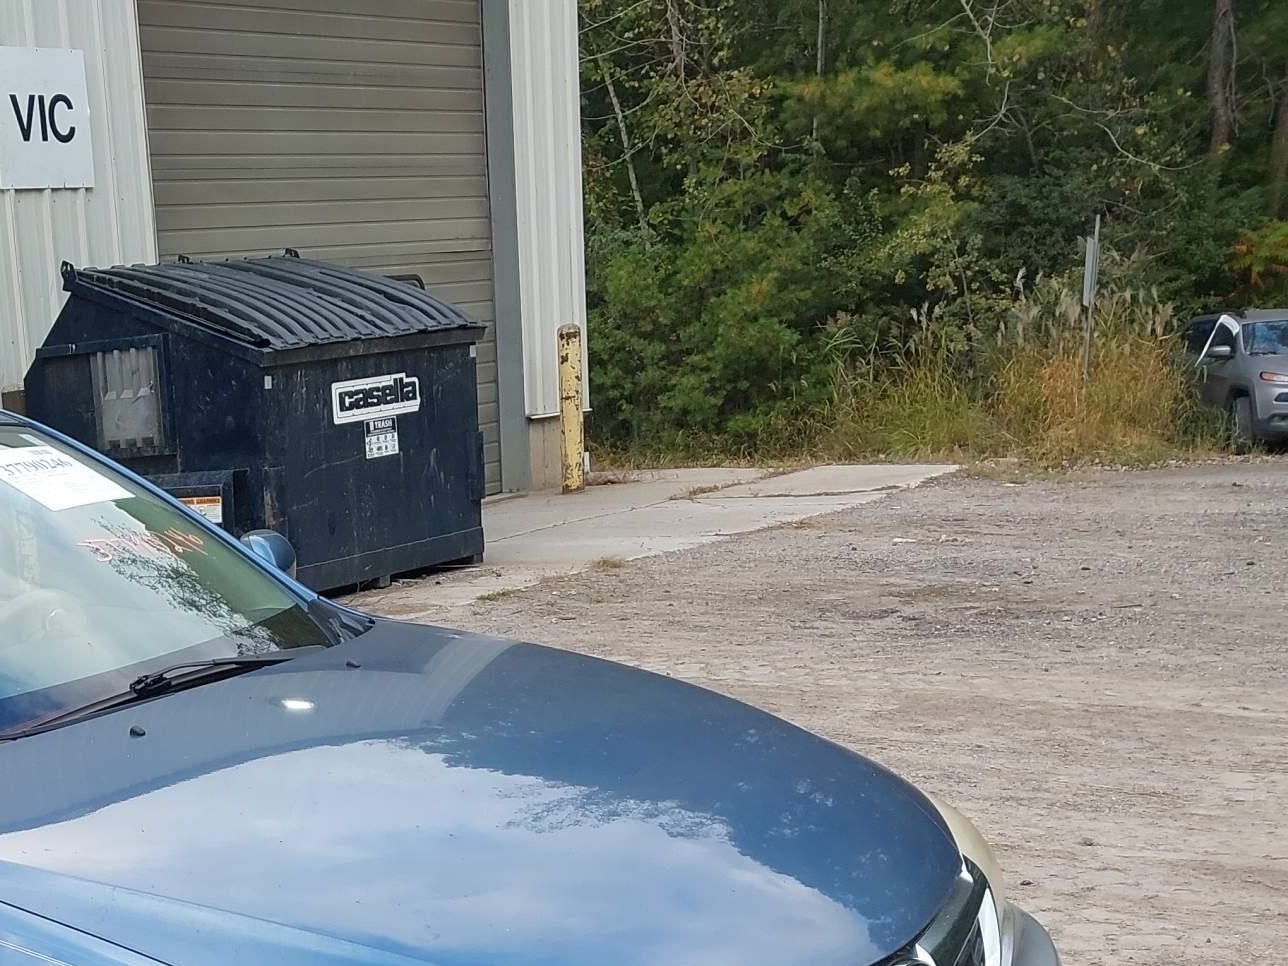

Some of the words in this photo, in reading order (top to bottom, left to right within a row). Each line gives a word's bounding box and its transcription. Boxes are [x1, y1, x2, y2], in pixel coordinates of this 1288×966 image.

[9, 94, 76, 144] VIC
[339, 377, 418, 412] casella
[375, 419, 393, 429] TRASH
